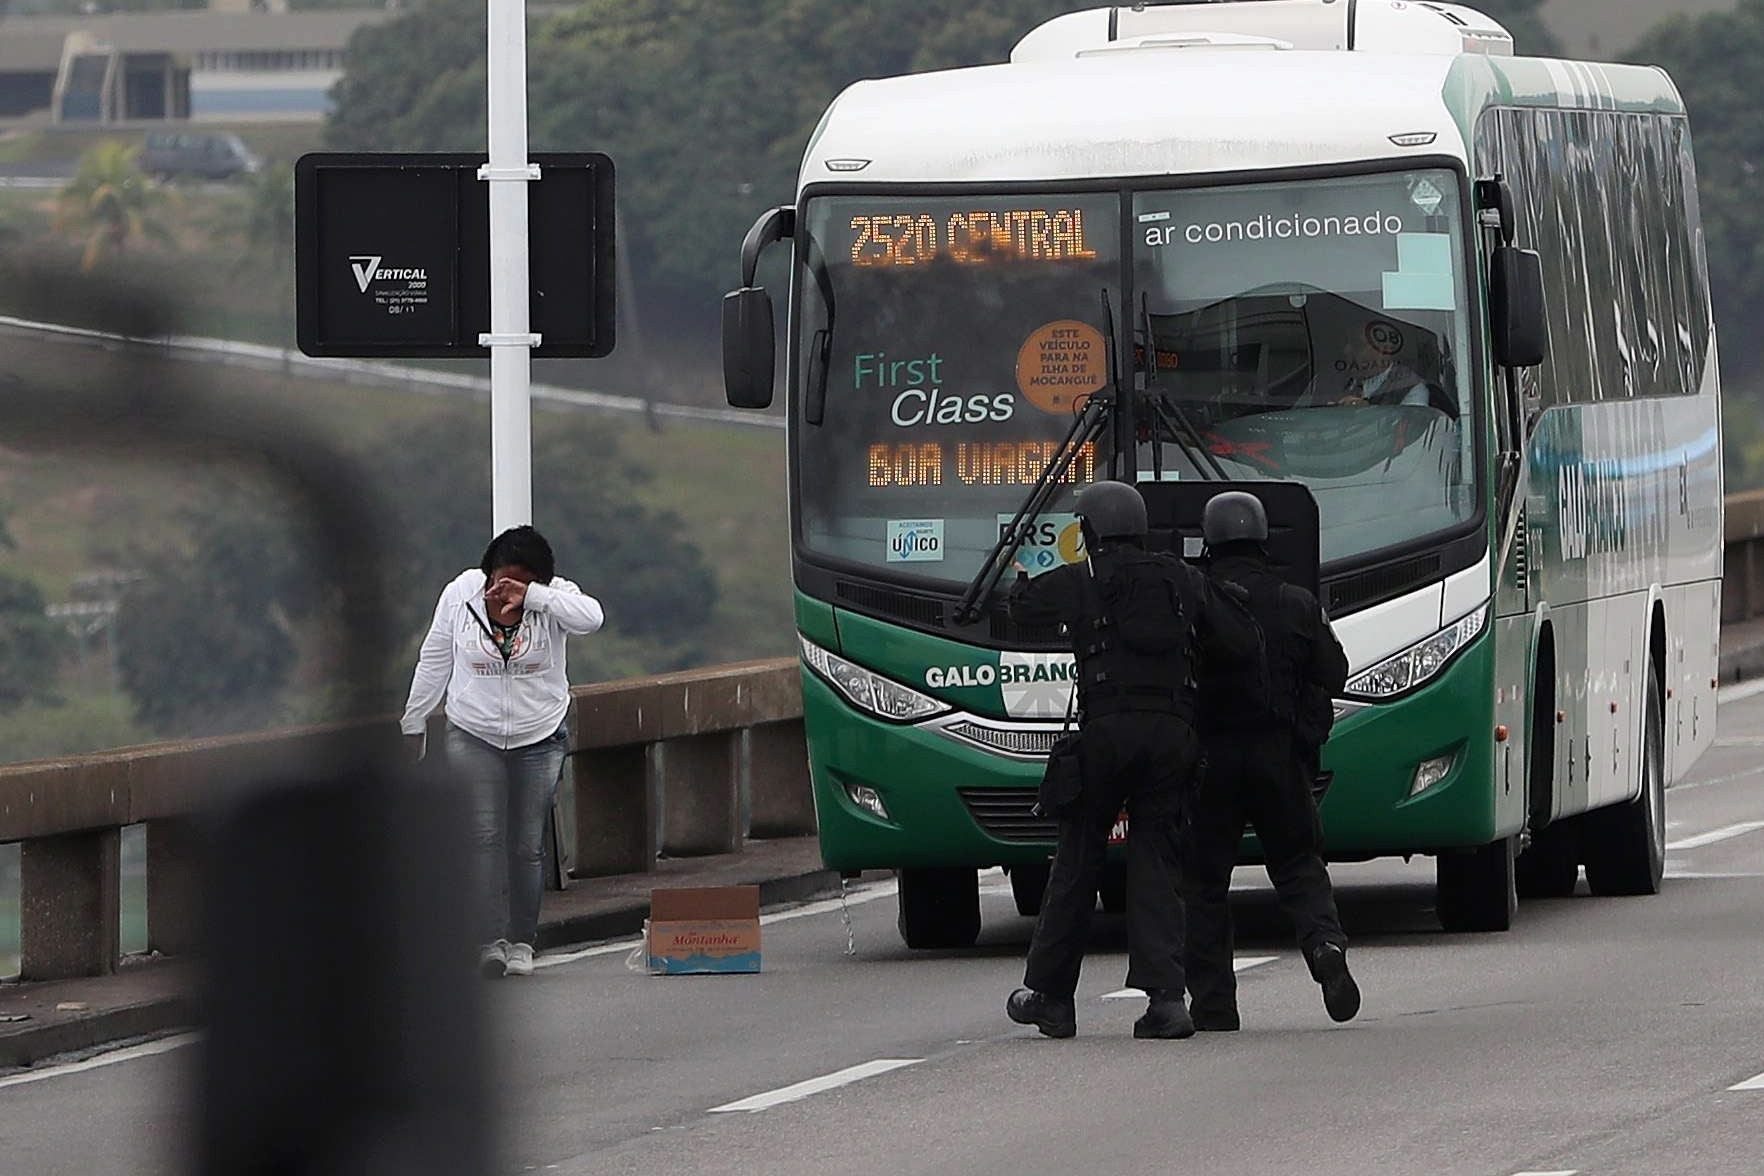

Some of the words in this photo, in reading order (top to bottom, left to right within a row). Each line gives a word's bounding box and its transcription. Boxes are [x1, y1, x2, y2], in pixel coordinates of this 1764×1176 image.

[850, 215, 937, 265] 2520
[947, 209, 1096, 262] CENTRAL
[1145, 226, 1175, 246] ar
[1185, 211, 1402, 244] condicionado
[349, 256, 427, 293] VERTICAL
[1040, 340, 1091, 350] VEÍCULO
[1052, 329, 1079, 338] ESTE
[855, 352, 943, 389] First
[1040, 353, 1069, 362] PARA
[1072, 352, 1089, 361] NA
[1042, 364, 1069, 374] ILHA
[1072, 364, 1087, 373] DE
[891, 388, 1015, 427] Class
[869, 442, 942, 486] BOA
[892, 532, 938, 554] ÚNICO
[1001, 523, 1057, 547] BRS
